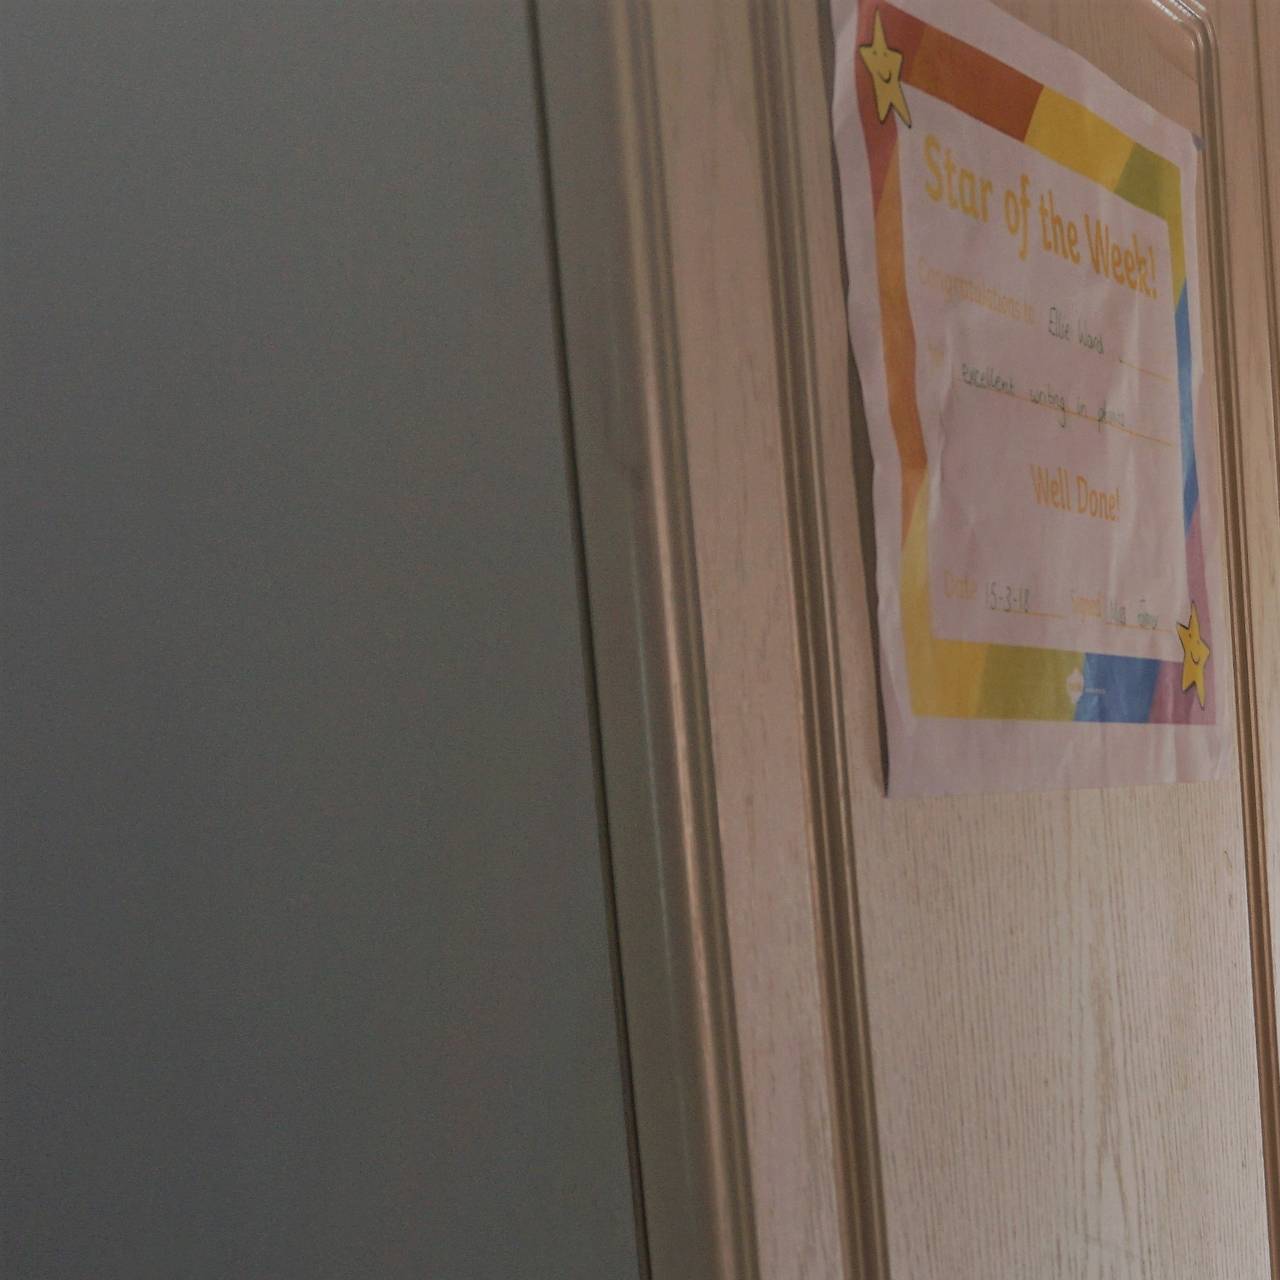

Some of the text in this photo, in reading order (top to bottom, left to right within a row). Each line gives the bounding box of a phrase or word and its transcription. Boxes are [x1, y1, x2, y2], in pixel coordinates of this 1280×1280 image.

[923, 132, 1157, 300] Star of the Week!
[1030, 463, 1121, 522] Well Done!
